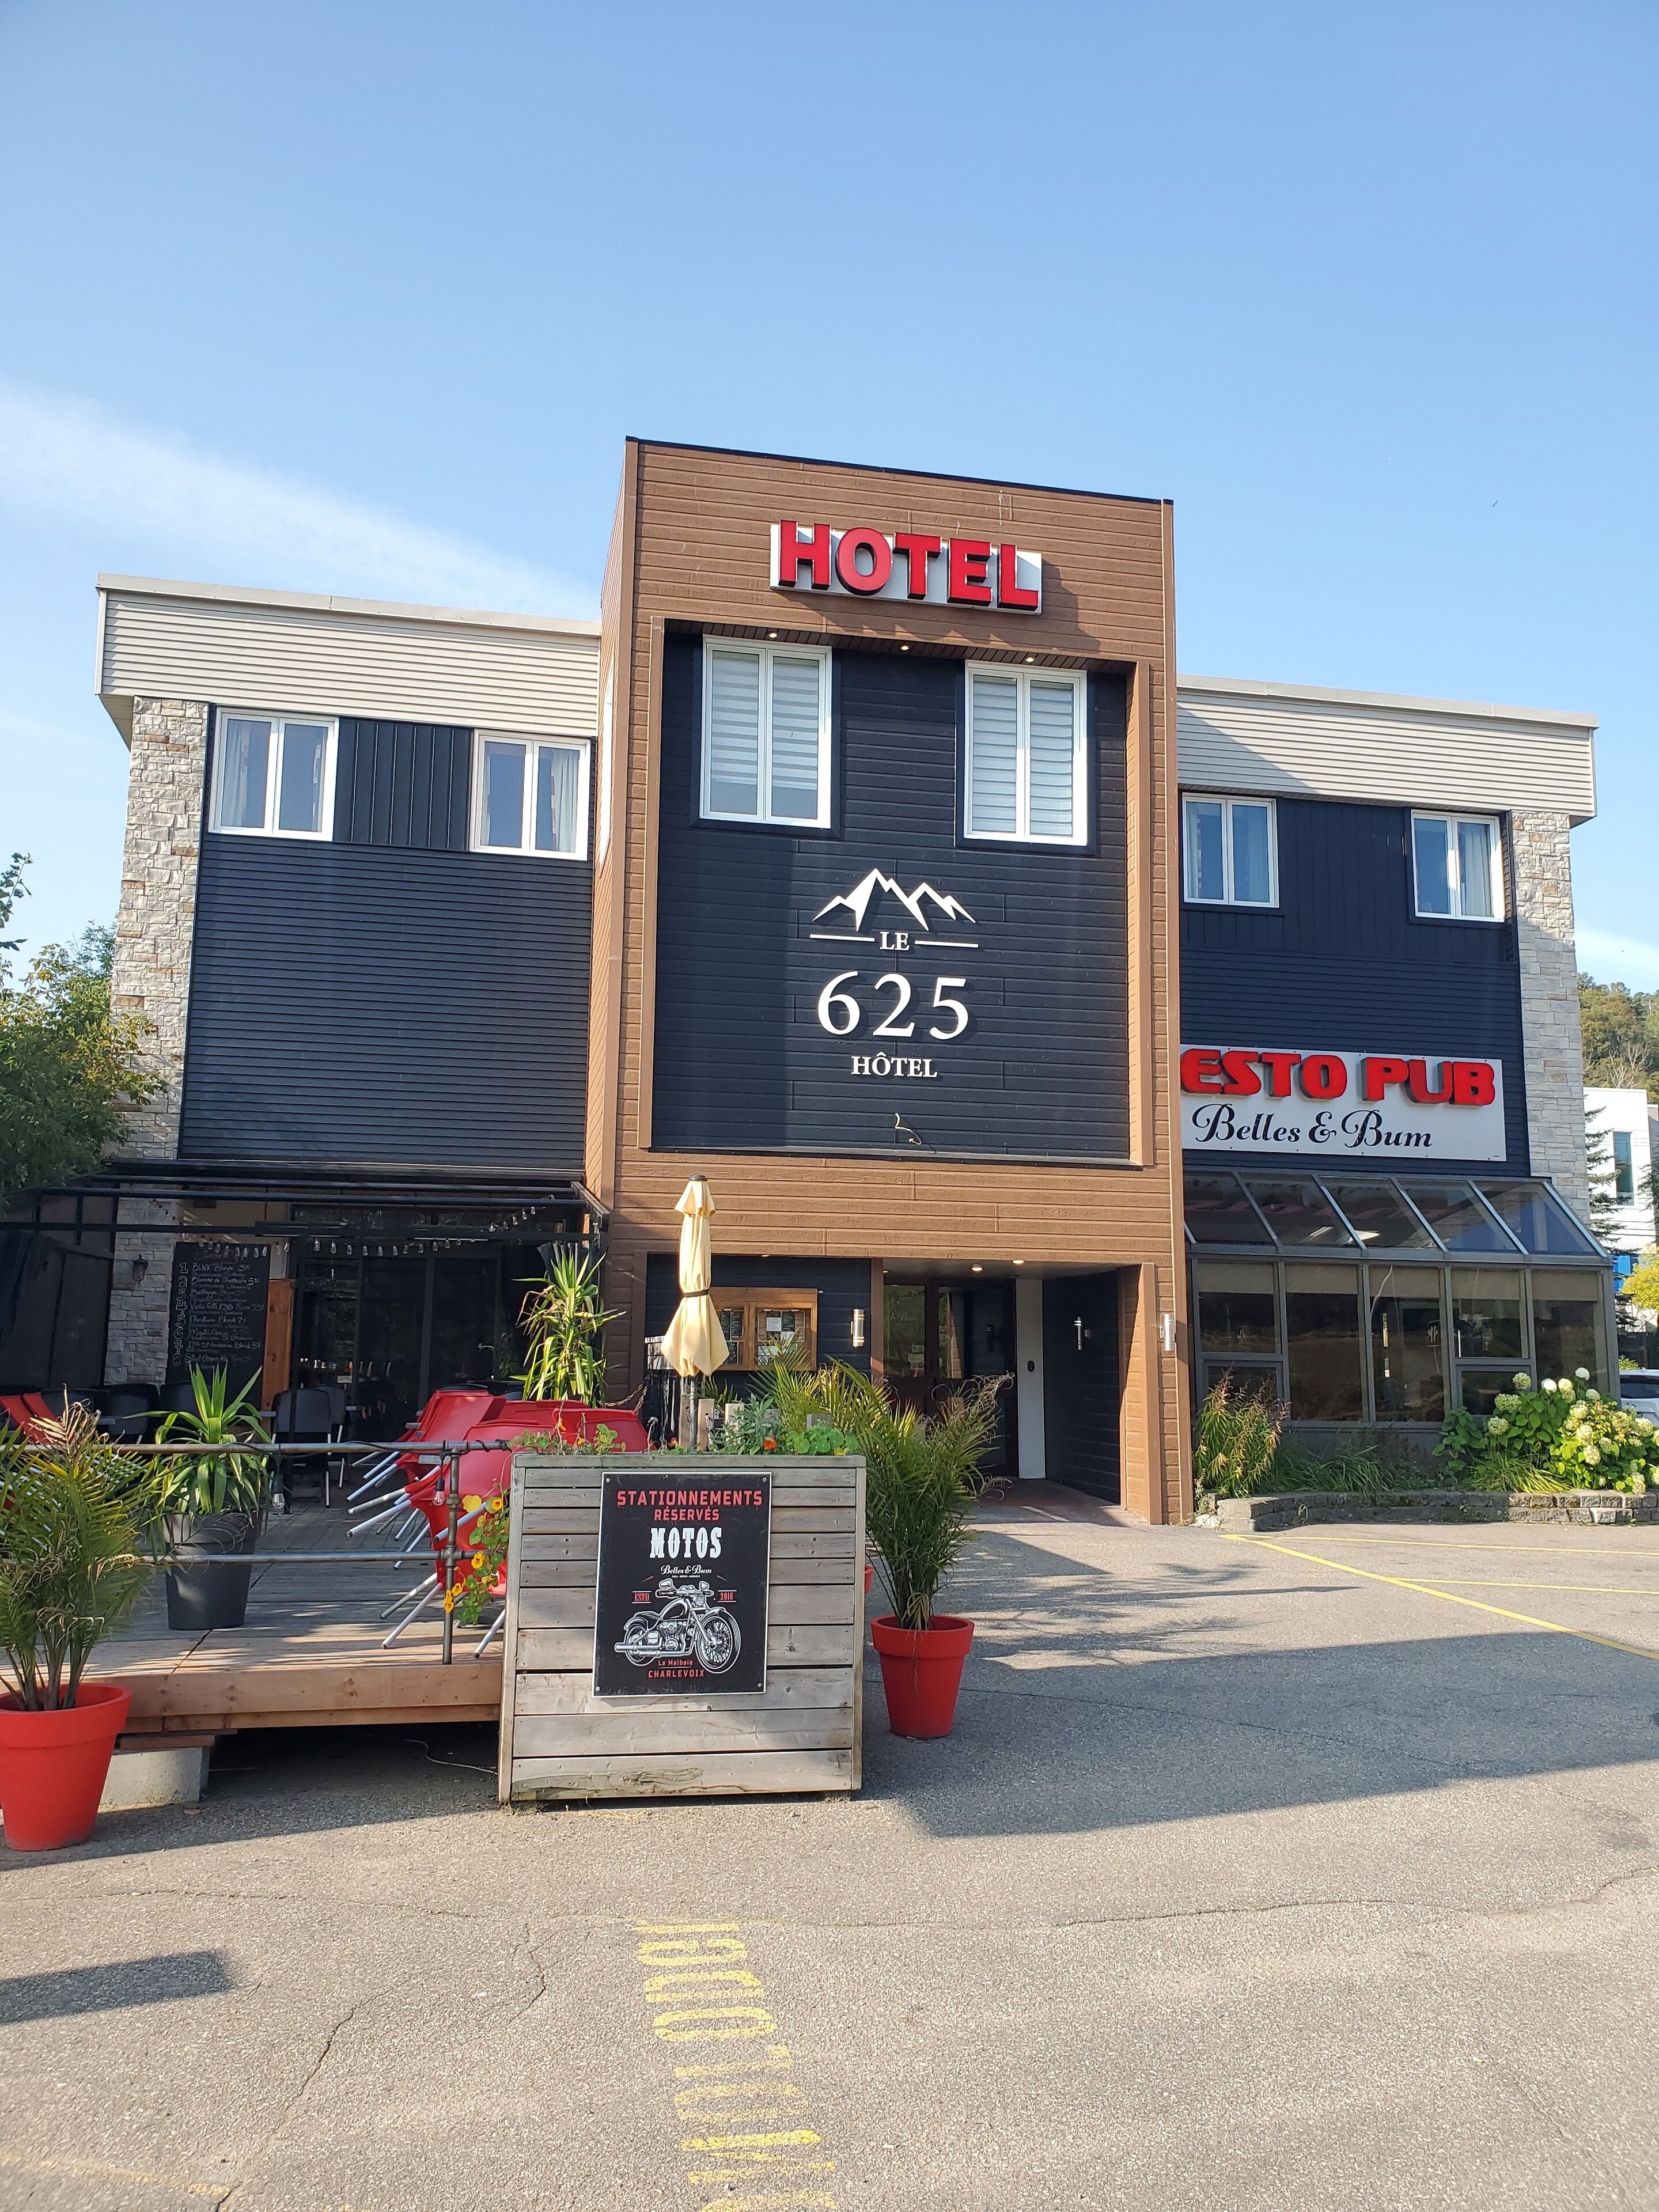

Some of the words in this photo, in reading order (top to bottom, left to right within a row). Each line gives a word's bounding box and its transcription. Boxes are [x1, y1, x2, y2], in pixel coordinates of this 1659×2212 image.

[778, 519, 1039, 611] HOTEL
[880, 931, 910, 951] LE
[818, 971, 968, 1040] 625
[851, 1051, 938, 1078] HÔTEL
[1360, 1057, 1495, 1107] PUB
[1192, 1103, 1301, 1142] Belles
[1308, 1111, 1336, 1143] &
[1340, 1109, 1433, 1148] Bum
[617, 1490, 762, 1506] STATIONNEMENTS
[653, 1506, 719, 1521] RÉSERVÉS
[650, 1527, 722, 1558] MOTOS
[661, 1565, 684, 1574] Belles
[685, 1565, 691, 1573] &
[692, 1565, 712, 1574] Bum
[720, 1592, 733, 1600] 2016
[648, 1669, 704, 1678] CHARLEVOIX
